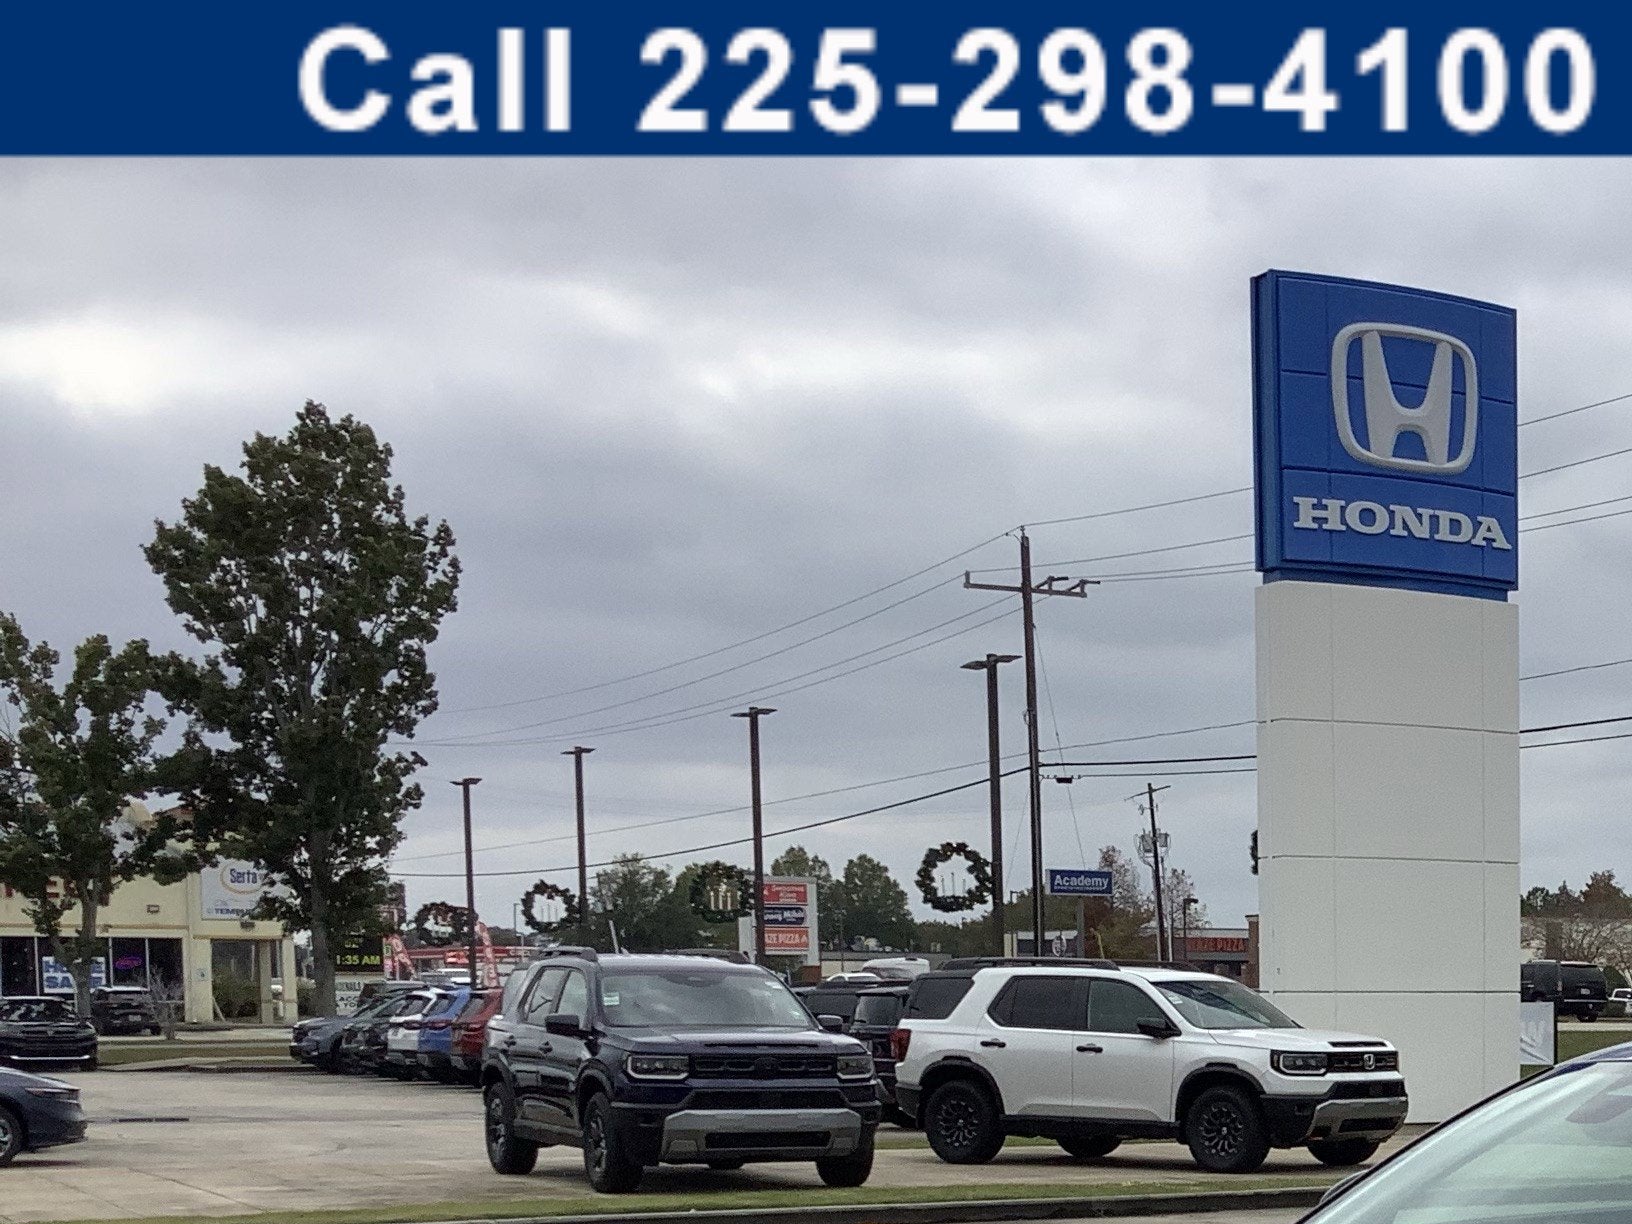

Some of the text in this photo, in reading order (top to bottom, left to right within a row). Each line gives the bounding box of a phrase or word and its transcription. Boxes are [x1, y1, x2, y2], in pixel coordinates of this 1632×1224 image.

[1293, 496, 1512, 550] HONDA
[229, 868, 258, 884] Serta
[1053, 874, 1109, 890] Academy
